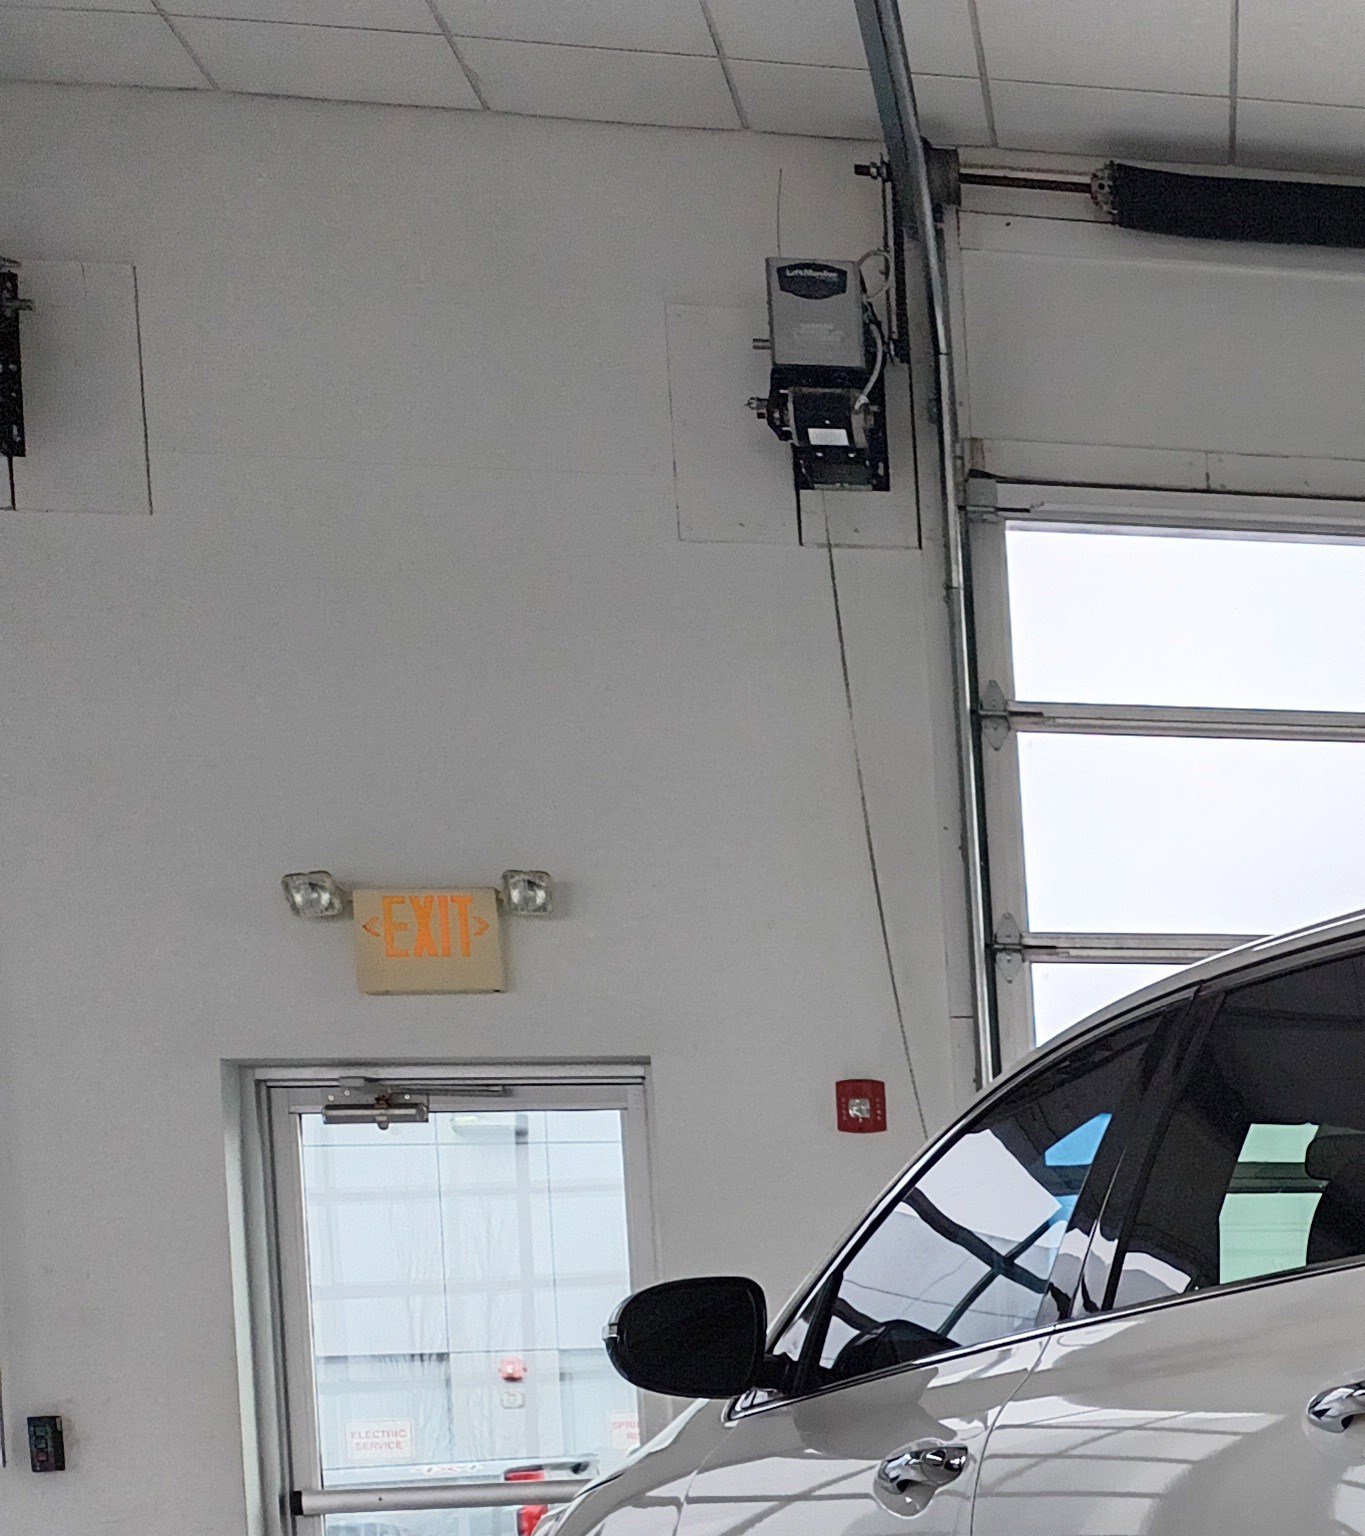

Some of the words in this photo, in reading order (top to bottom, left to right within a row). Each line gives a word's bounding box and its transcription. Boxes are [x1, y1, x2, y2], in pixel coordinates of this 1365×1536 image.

[382, 895, 473, 957] EXIT
[350, 1429, 408, 1439] ELECTRIC
[355, 1440, 403, 1451] SERVICE
